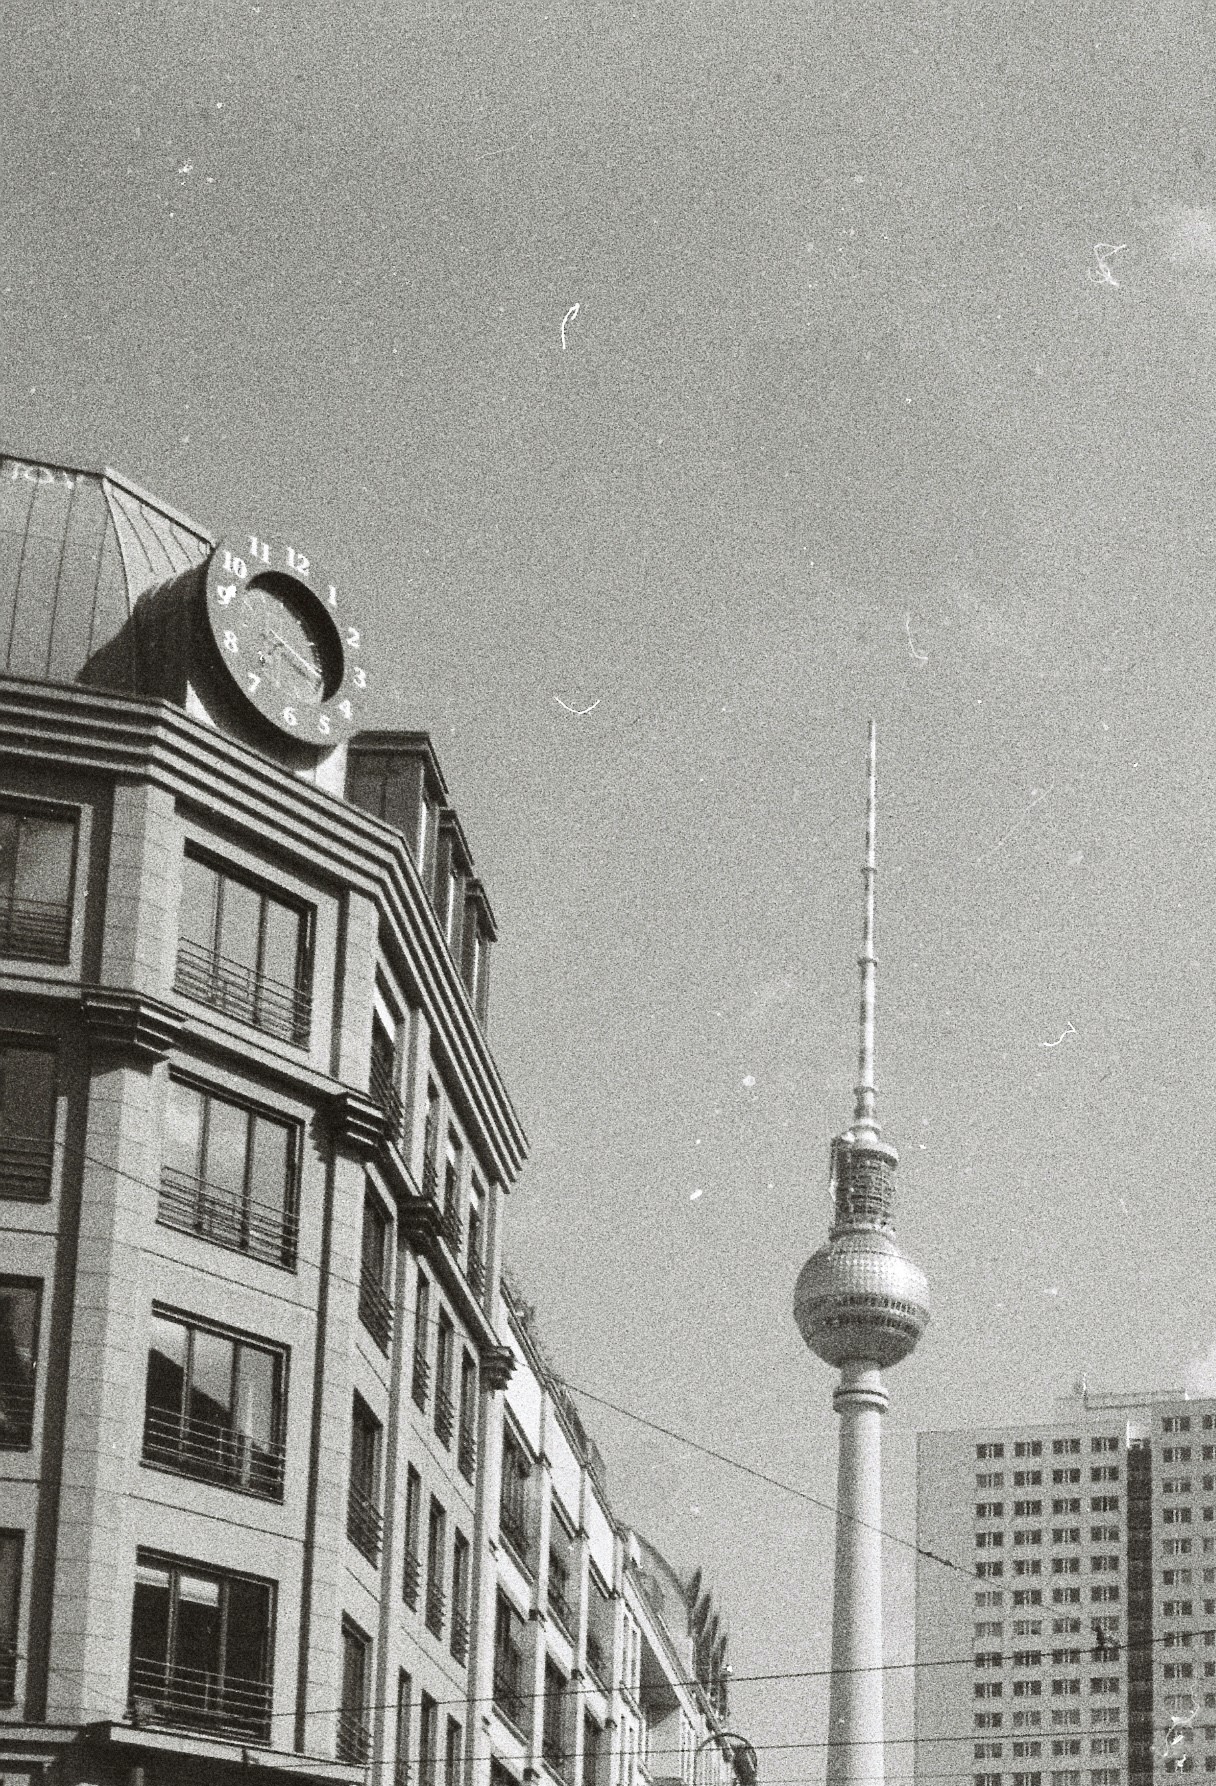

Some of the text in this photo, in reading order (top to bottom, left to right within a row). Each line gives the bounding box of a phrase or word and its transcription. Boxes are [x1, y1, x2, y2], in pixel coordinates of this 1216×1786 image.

[251, 536, 271, 565] 11
[286, 546, 310, 577] 12
[223, 551, 248, 579] 10
[217, 584, 237, 605] 9
[329, 584, 338, 608] 1
[223, 630, 239, 653] 8
[347, 626, 361, 649] 2
[249, 672, 262, 694] 7
[353, 666, 367, 688] 3
[282, 706, 298, 727] 6
[340, 699, 352, 720] 4
[318, 714, 331, 735] 5
